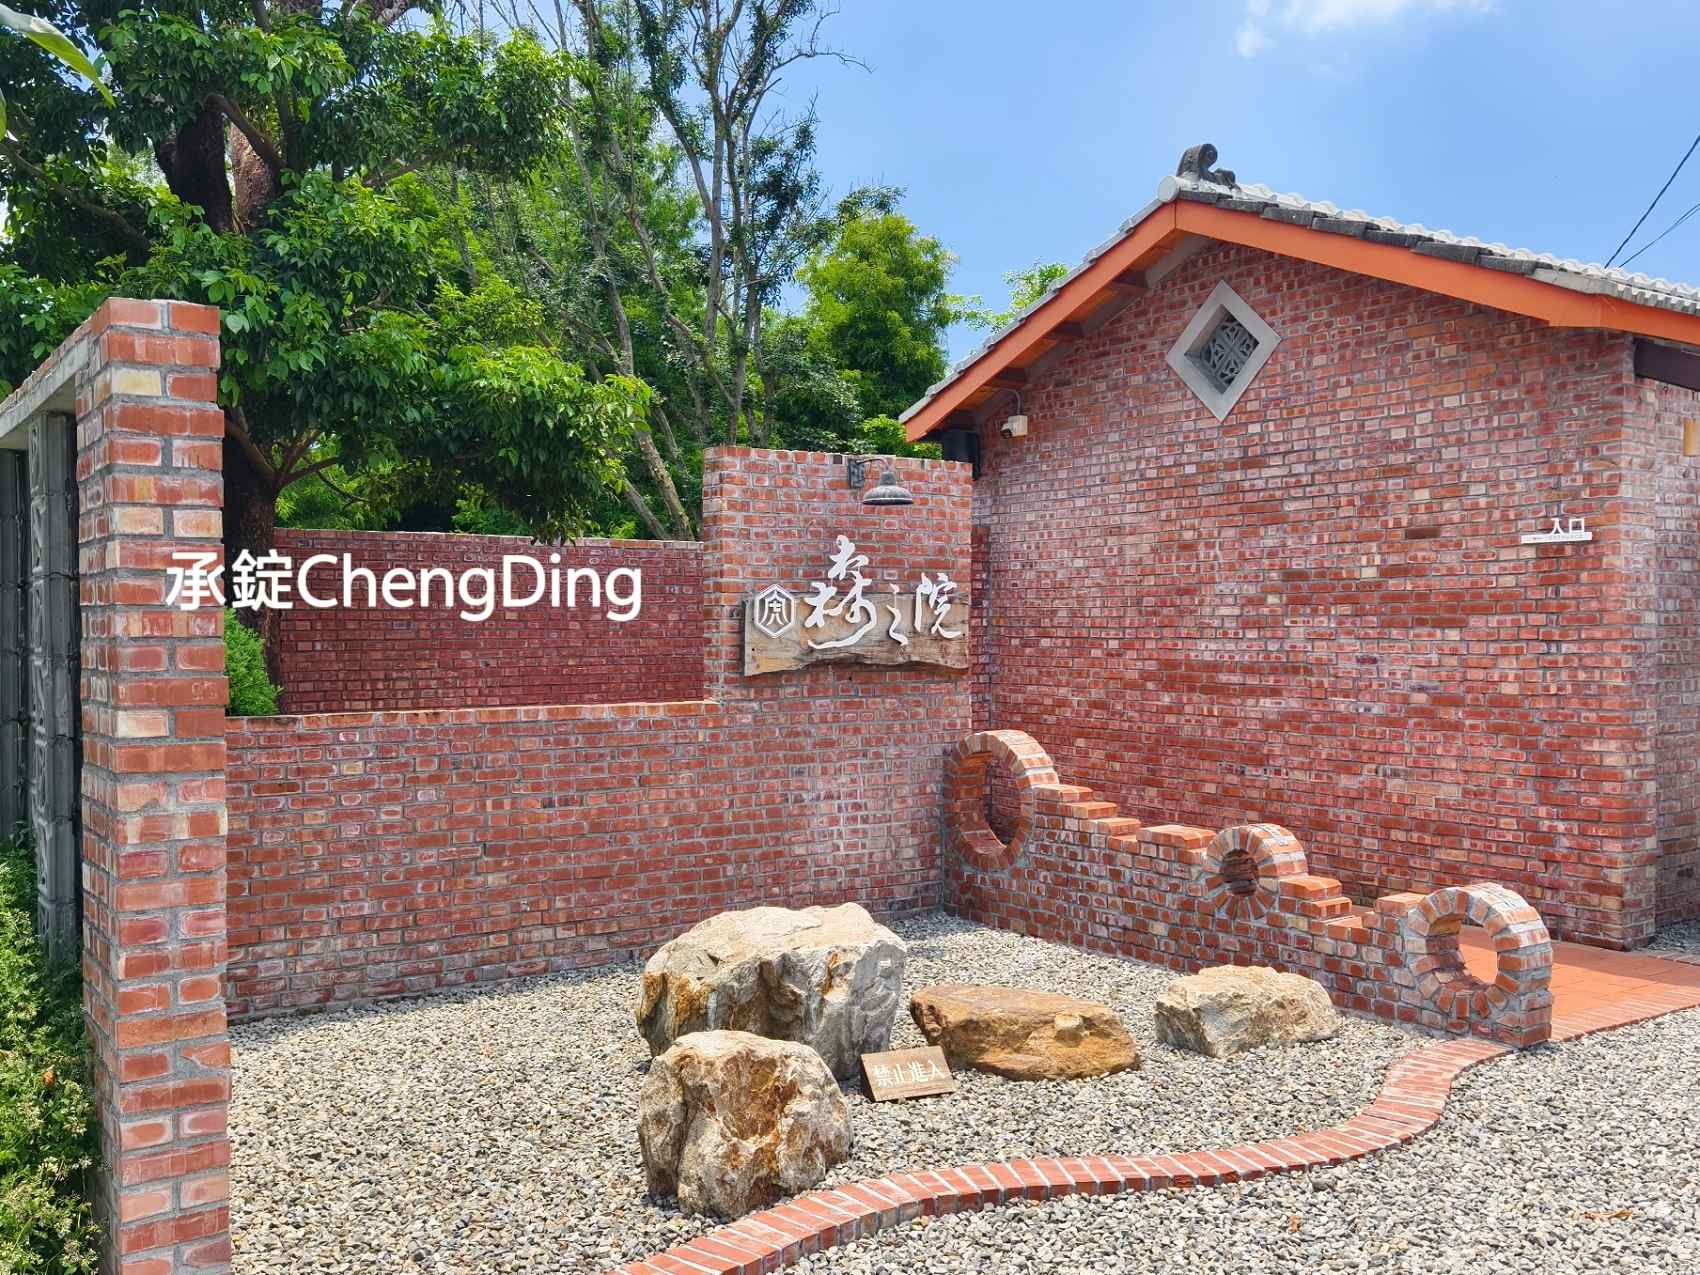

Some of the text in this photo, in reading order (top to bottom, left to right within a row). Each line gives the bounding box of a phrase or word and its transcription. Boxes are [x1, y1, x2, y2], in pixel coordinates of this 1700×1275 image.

[1550, 518, 1584, 535] 入口
[873, 1060, 945, 1088] 禁止進入
